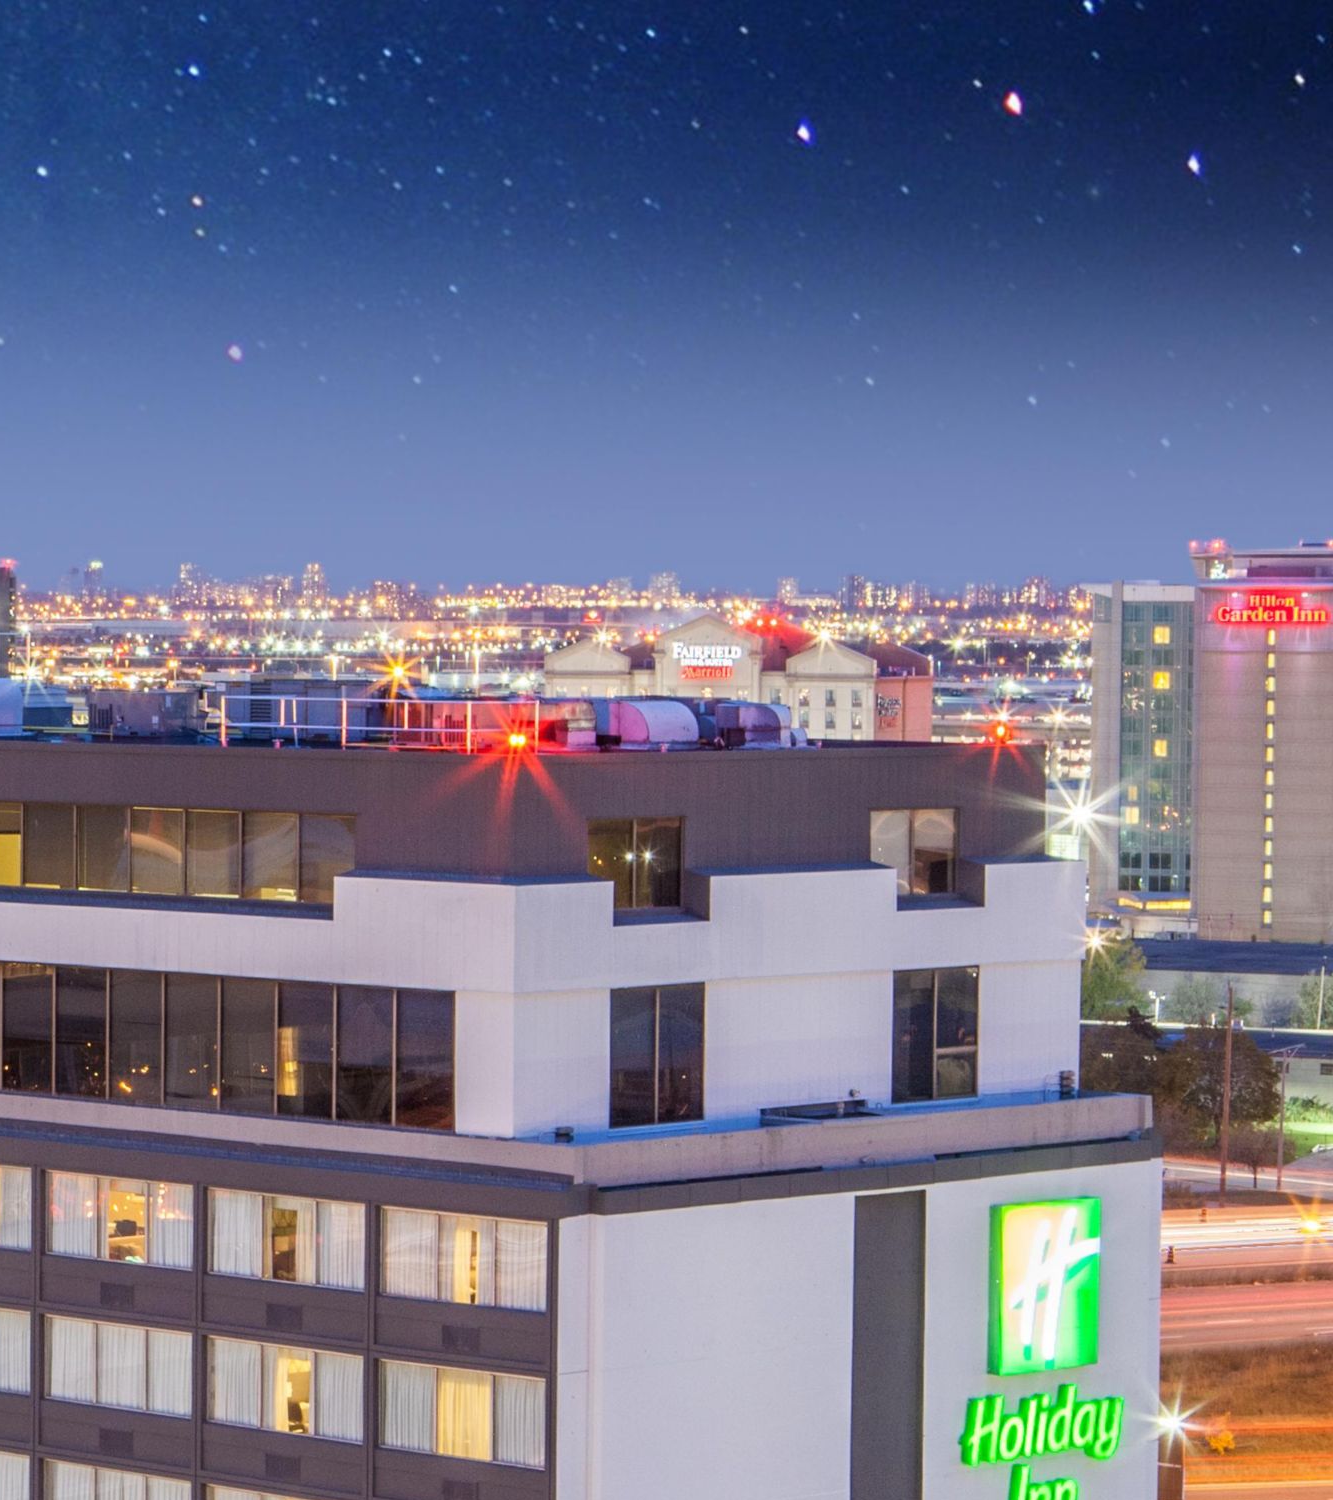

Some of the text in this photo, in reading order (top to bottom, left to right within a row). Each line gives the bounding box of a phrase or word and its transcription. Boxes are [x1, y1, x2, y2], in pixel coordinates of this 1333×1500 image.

[1249, 595, 1295, 607] Hilton
[1218, 606, 1326, 622] Garden Inn
[672, 642, 741, 659] FAIRFIELD
[958, 1384, 1123, 1467] Holiday
